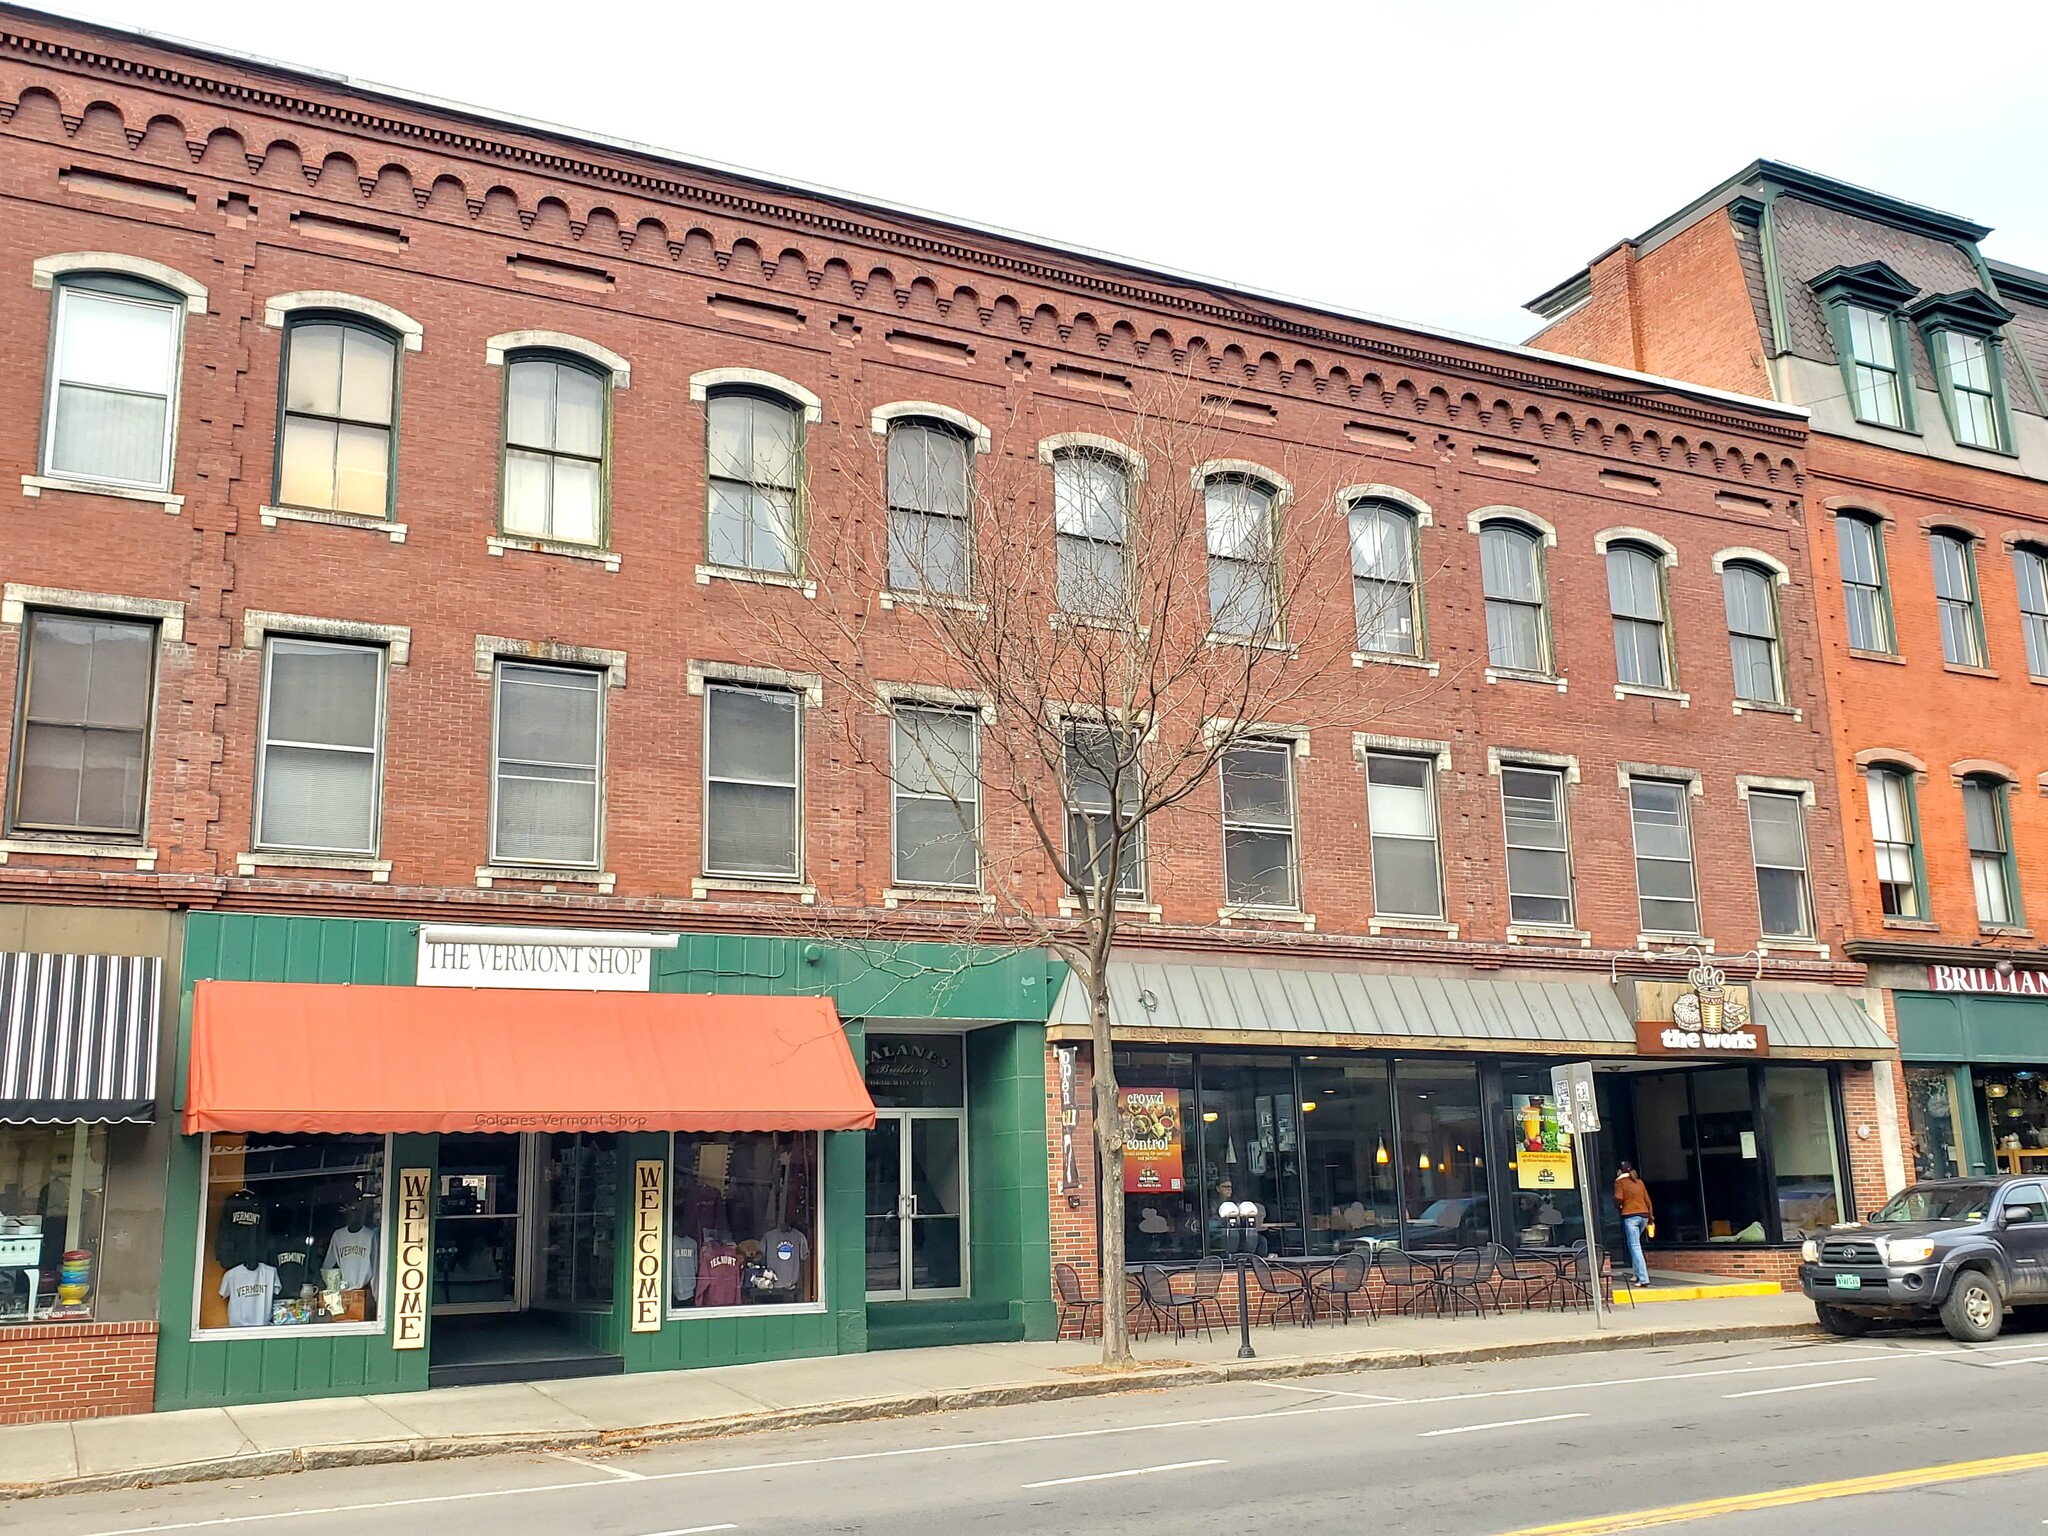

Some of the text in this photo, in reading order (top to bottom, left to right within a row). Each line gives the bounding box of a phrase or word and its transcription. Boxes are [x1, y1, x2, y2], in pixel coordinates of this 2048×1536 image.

[427, 943, 643, 975] THE VERMONT SHOP
[1660, 1028, 1758, 1050] the works
[876, 1063, 929, 1077] Building
[1127, 1091, 1165, 1104] crowd
[475, 1112, 648, 1129] Galanes Vermont Shop
[1126, 1137, 1169, 1151] control
[232, 1211, 261, 1225] VERMONT
[340, 1245, 367, 1259] VERMONT
[636, 1166, 662, 1325] WELCOME
[277, 1251, 306, 1267] VERMONT
[399, 1175, 429, 1340] WELCOME
[236, 1284, 268, 1298] VERMONT
